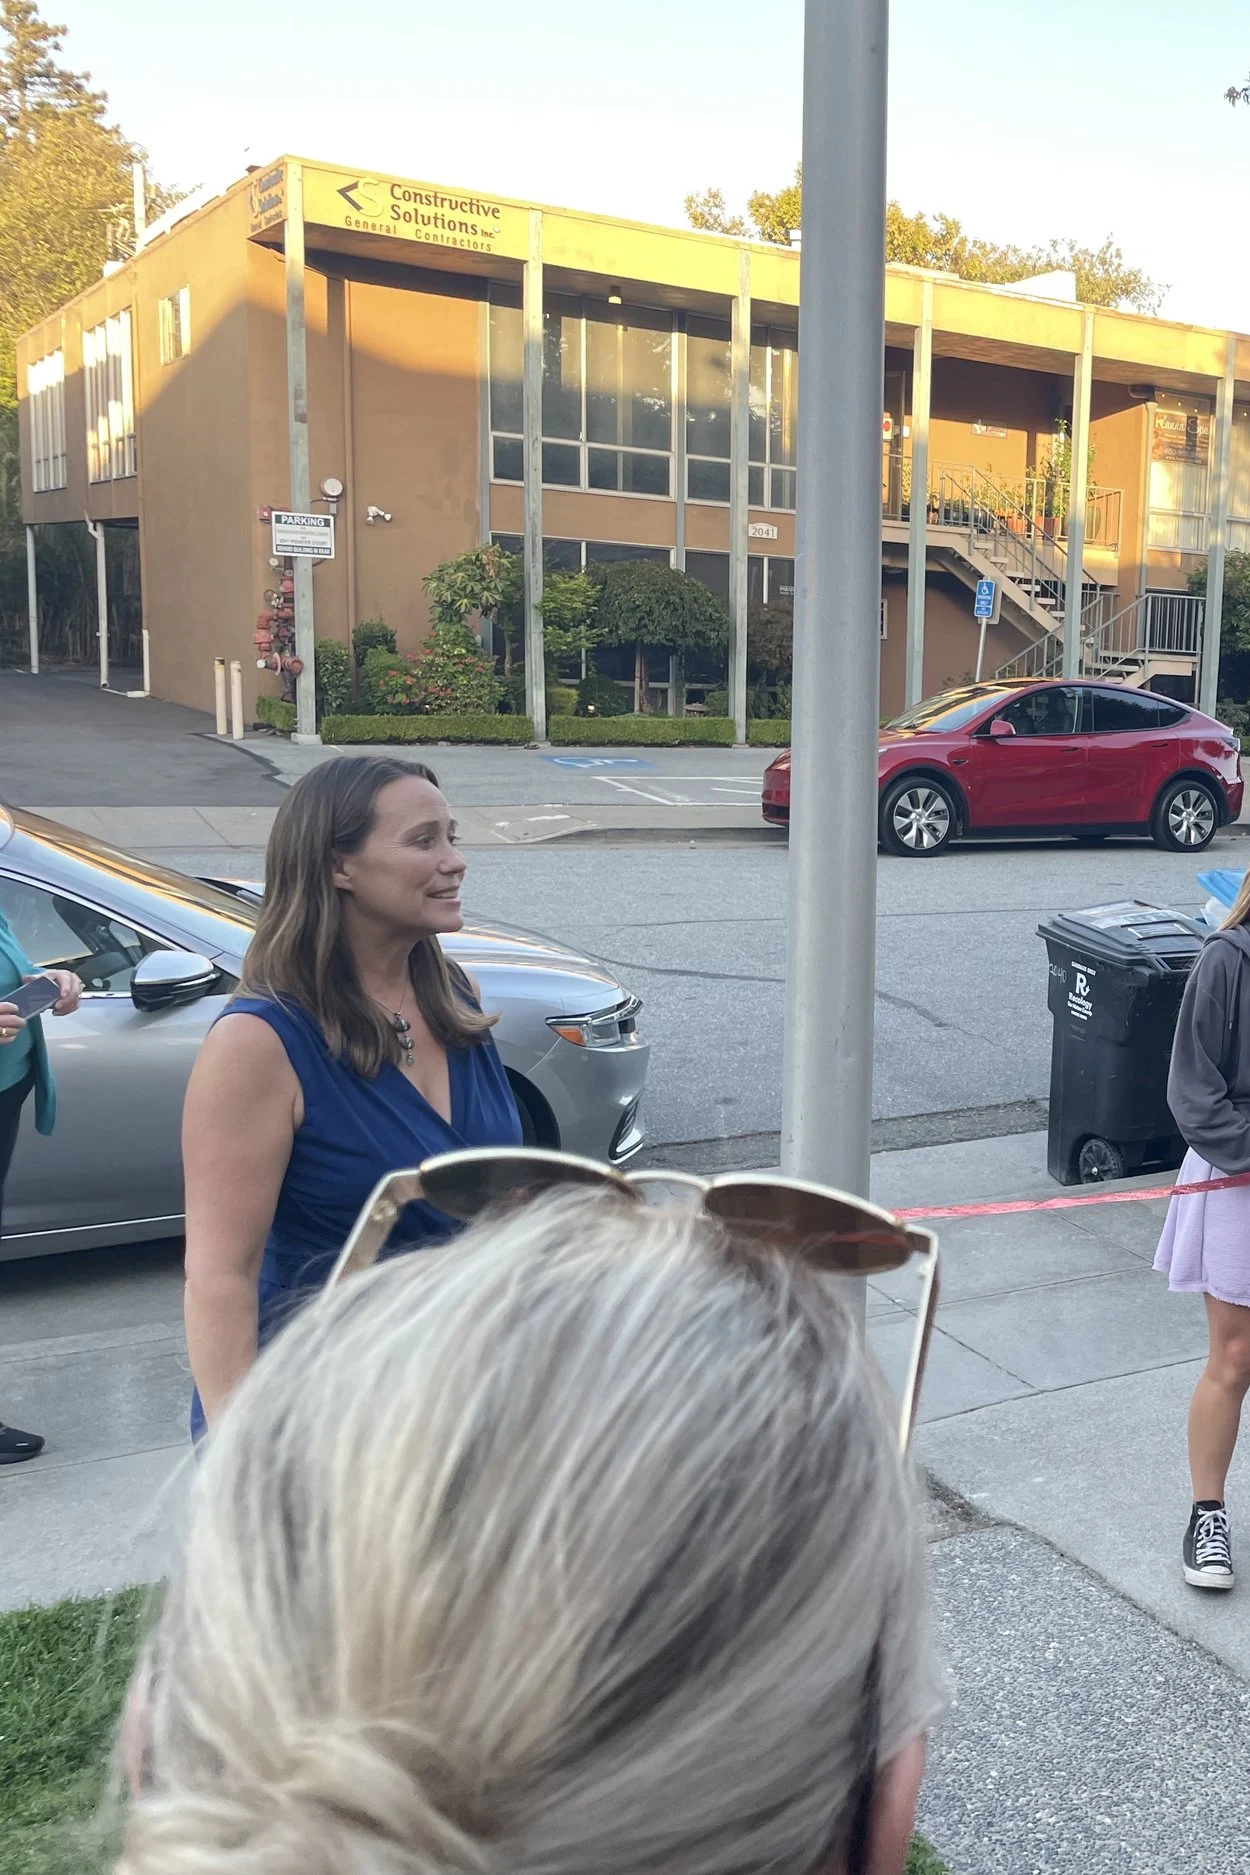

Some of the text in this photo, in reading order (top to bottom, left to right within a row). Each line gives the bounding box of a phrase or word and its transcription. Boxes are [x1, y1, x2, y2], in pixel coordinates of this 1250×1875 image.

[390, 183, 501, 219] Constructive
[344, 215, 492, 252] General Contractors
[390, 204, 496, 239] Solutions Inc.
[281, 515, 325, 527] PARKING
[752, 527, 776, 537] 2041
[1068, 991, 1093, 1010] Recology
